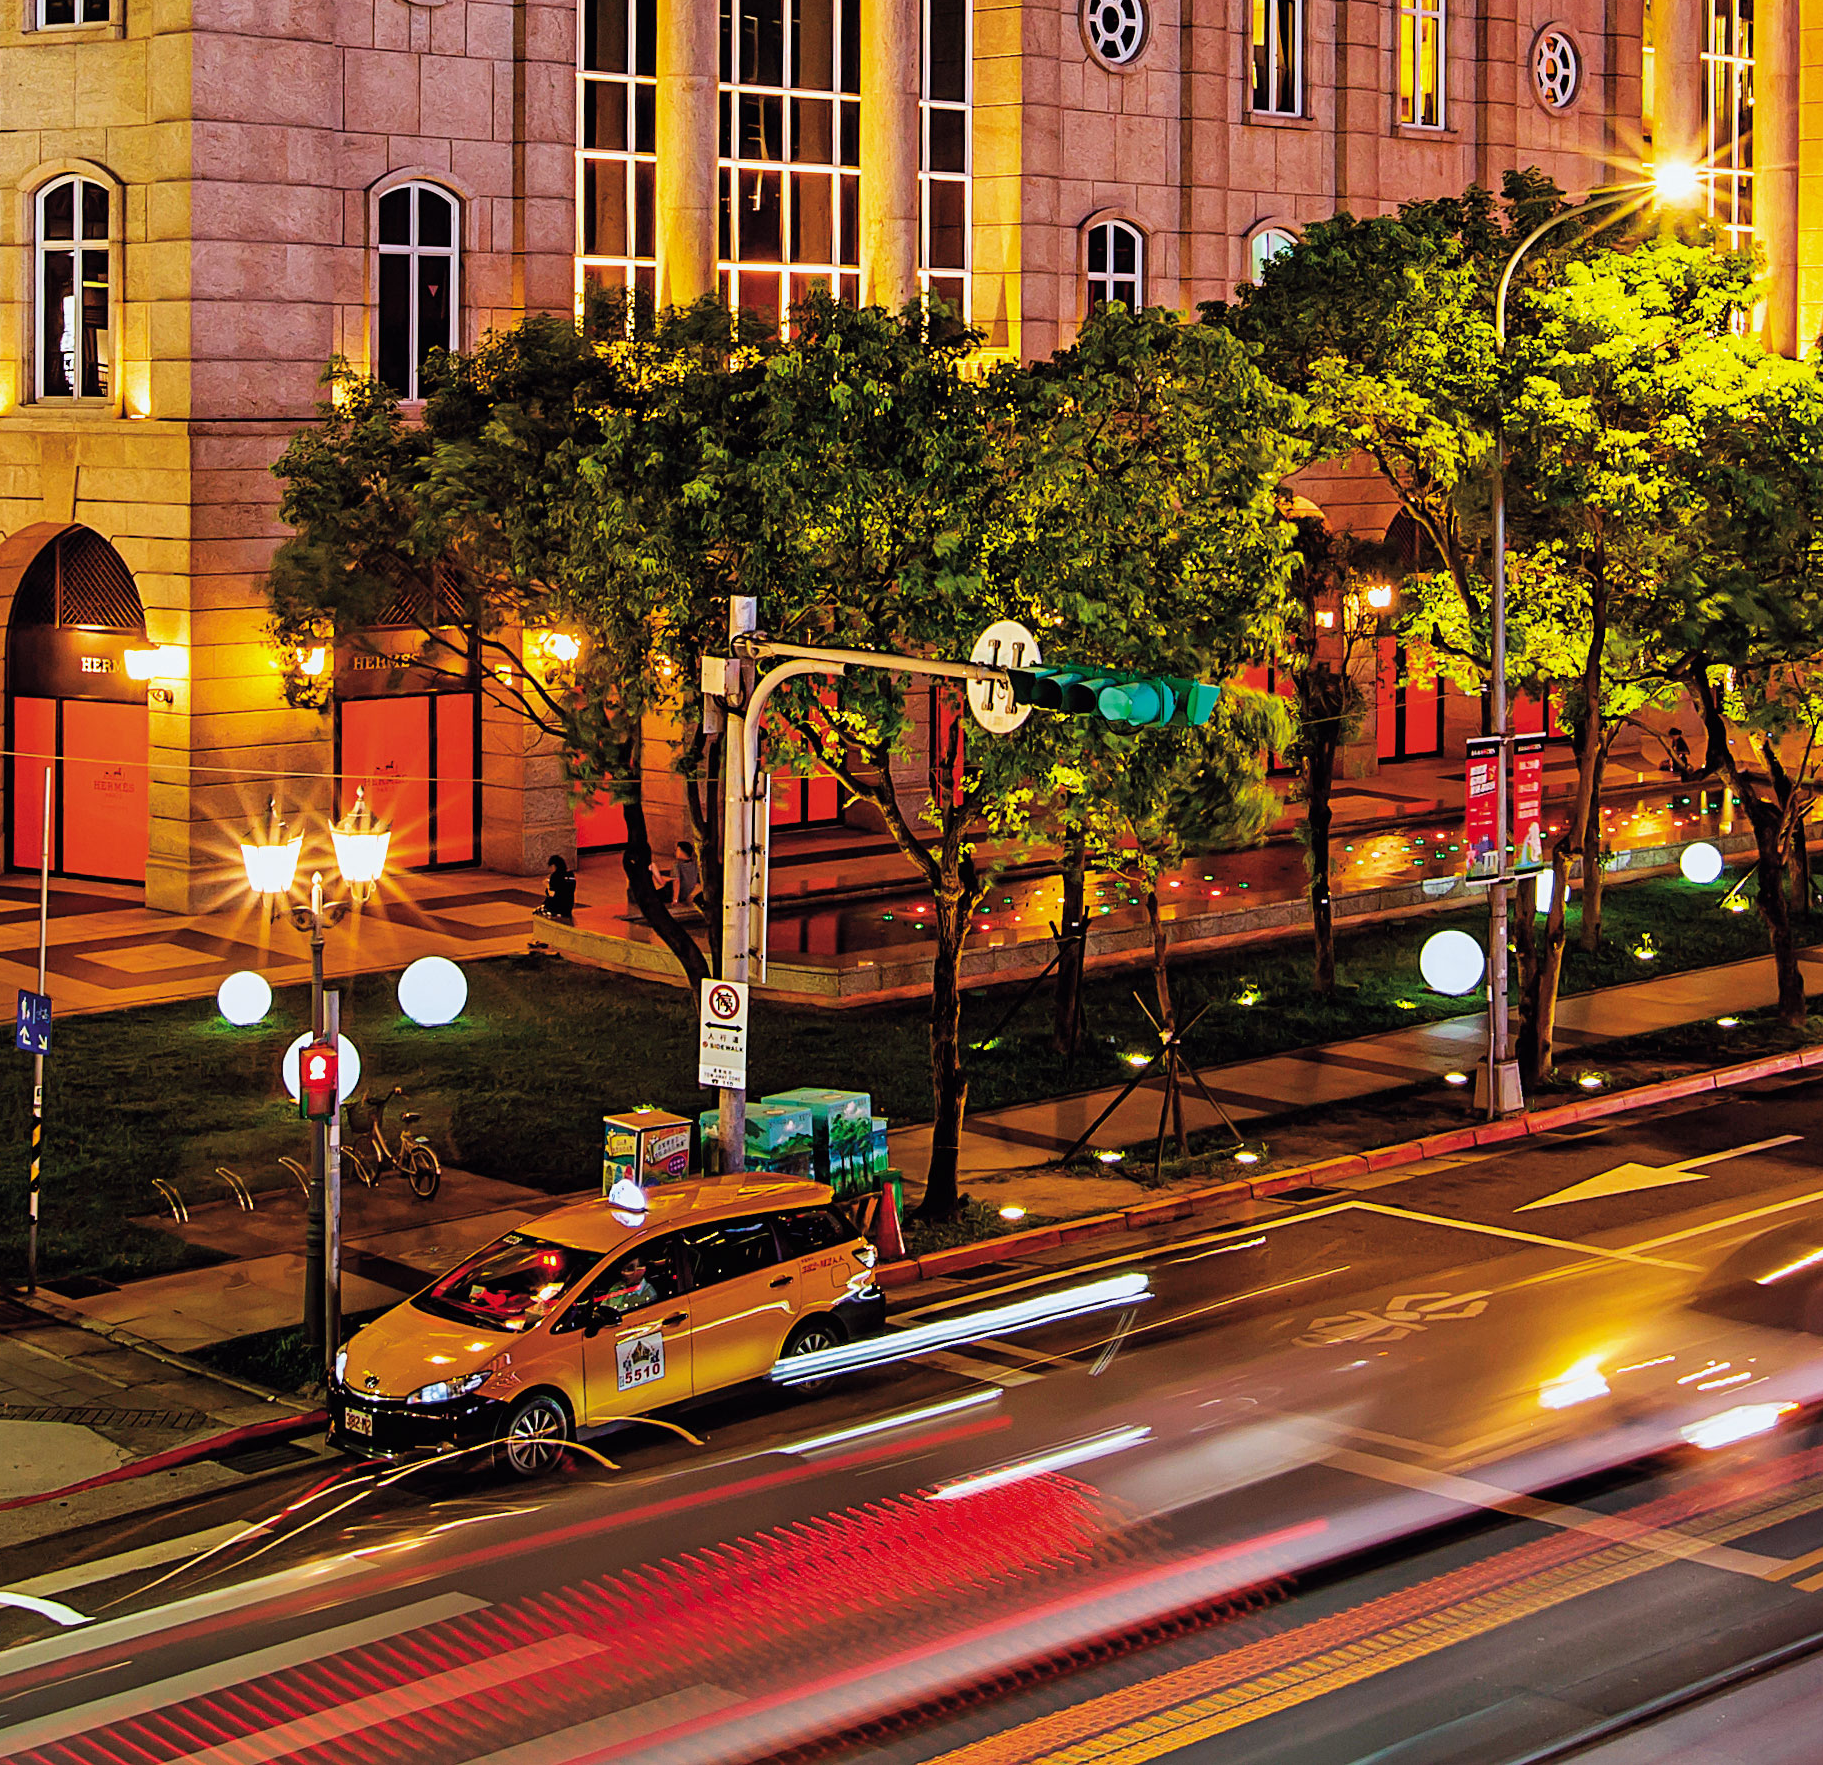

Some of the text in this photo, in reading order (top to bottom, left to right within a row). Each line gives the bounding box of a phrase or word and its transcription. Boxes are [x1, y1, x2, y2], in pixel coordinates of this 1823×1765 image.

[81, 657, 122, 673] HERM
[716, 993, 733, 1012] 停
[710, 1043, 743, 1053] SIDEWALK
[625, 1363, 660, 1384] 5510
